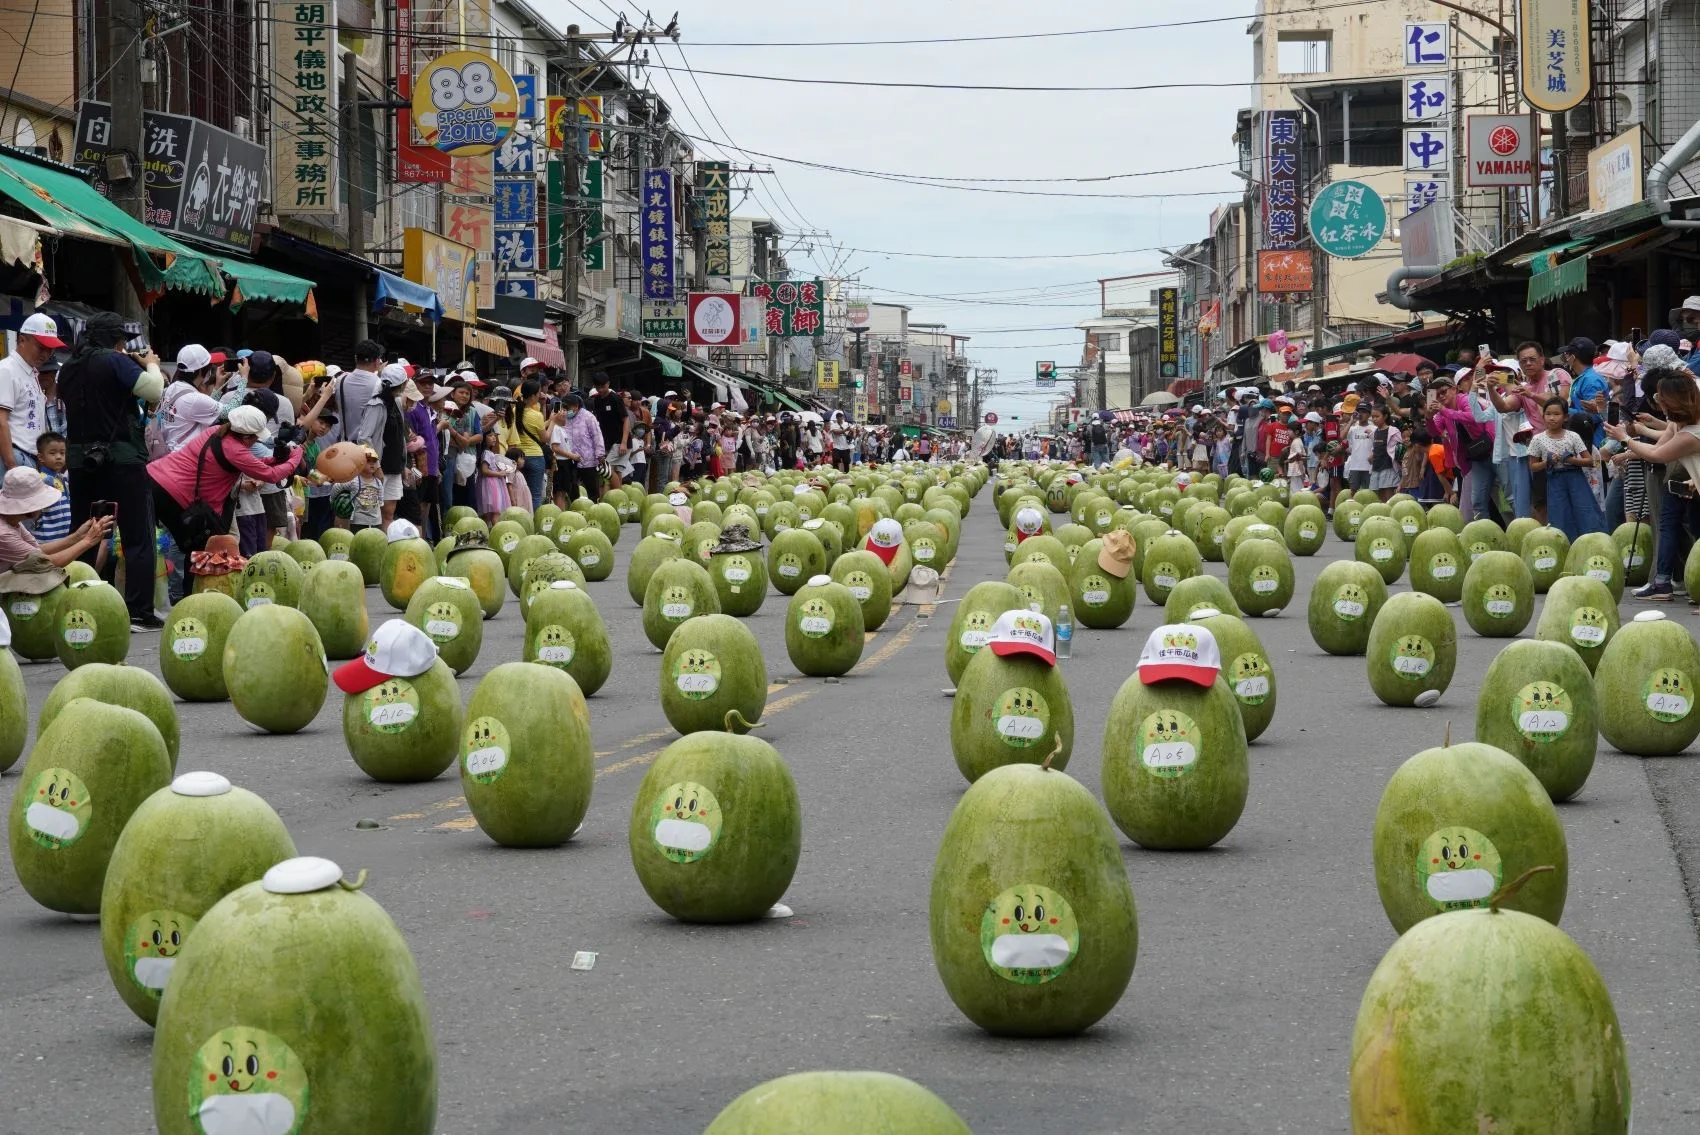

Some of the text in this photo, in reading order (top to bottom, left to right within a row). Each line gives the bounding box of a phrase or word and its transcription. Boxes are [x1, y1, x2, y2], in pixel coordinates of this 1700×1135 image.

[1545, 29, 1567, 93] 美芝城
[429, 61, 498, 111] 88
[294, 3, 327, 206] 胡平儀地政士事務所
[85, 116, 179, 158] 自洗
[1476, 160, 1532, 175] YAMAHA
[705, 163, 729, 275] 大成藥局
[1319, 222, 1380, 243] 紅茶冰
[1006, 718, 1033, 734] A11
[1528, 713, 1557, 729] A12
[471, 754, 497, 771] A04
[1149, 747, 1184, 761] A05
